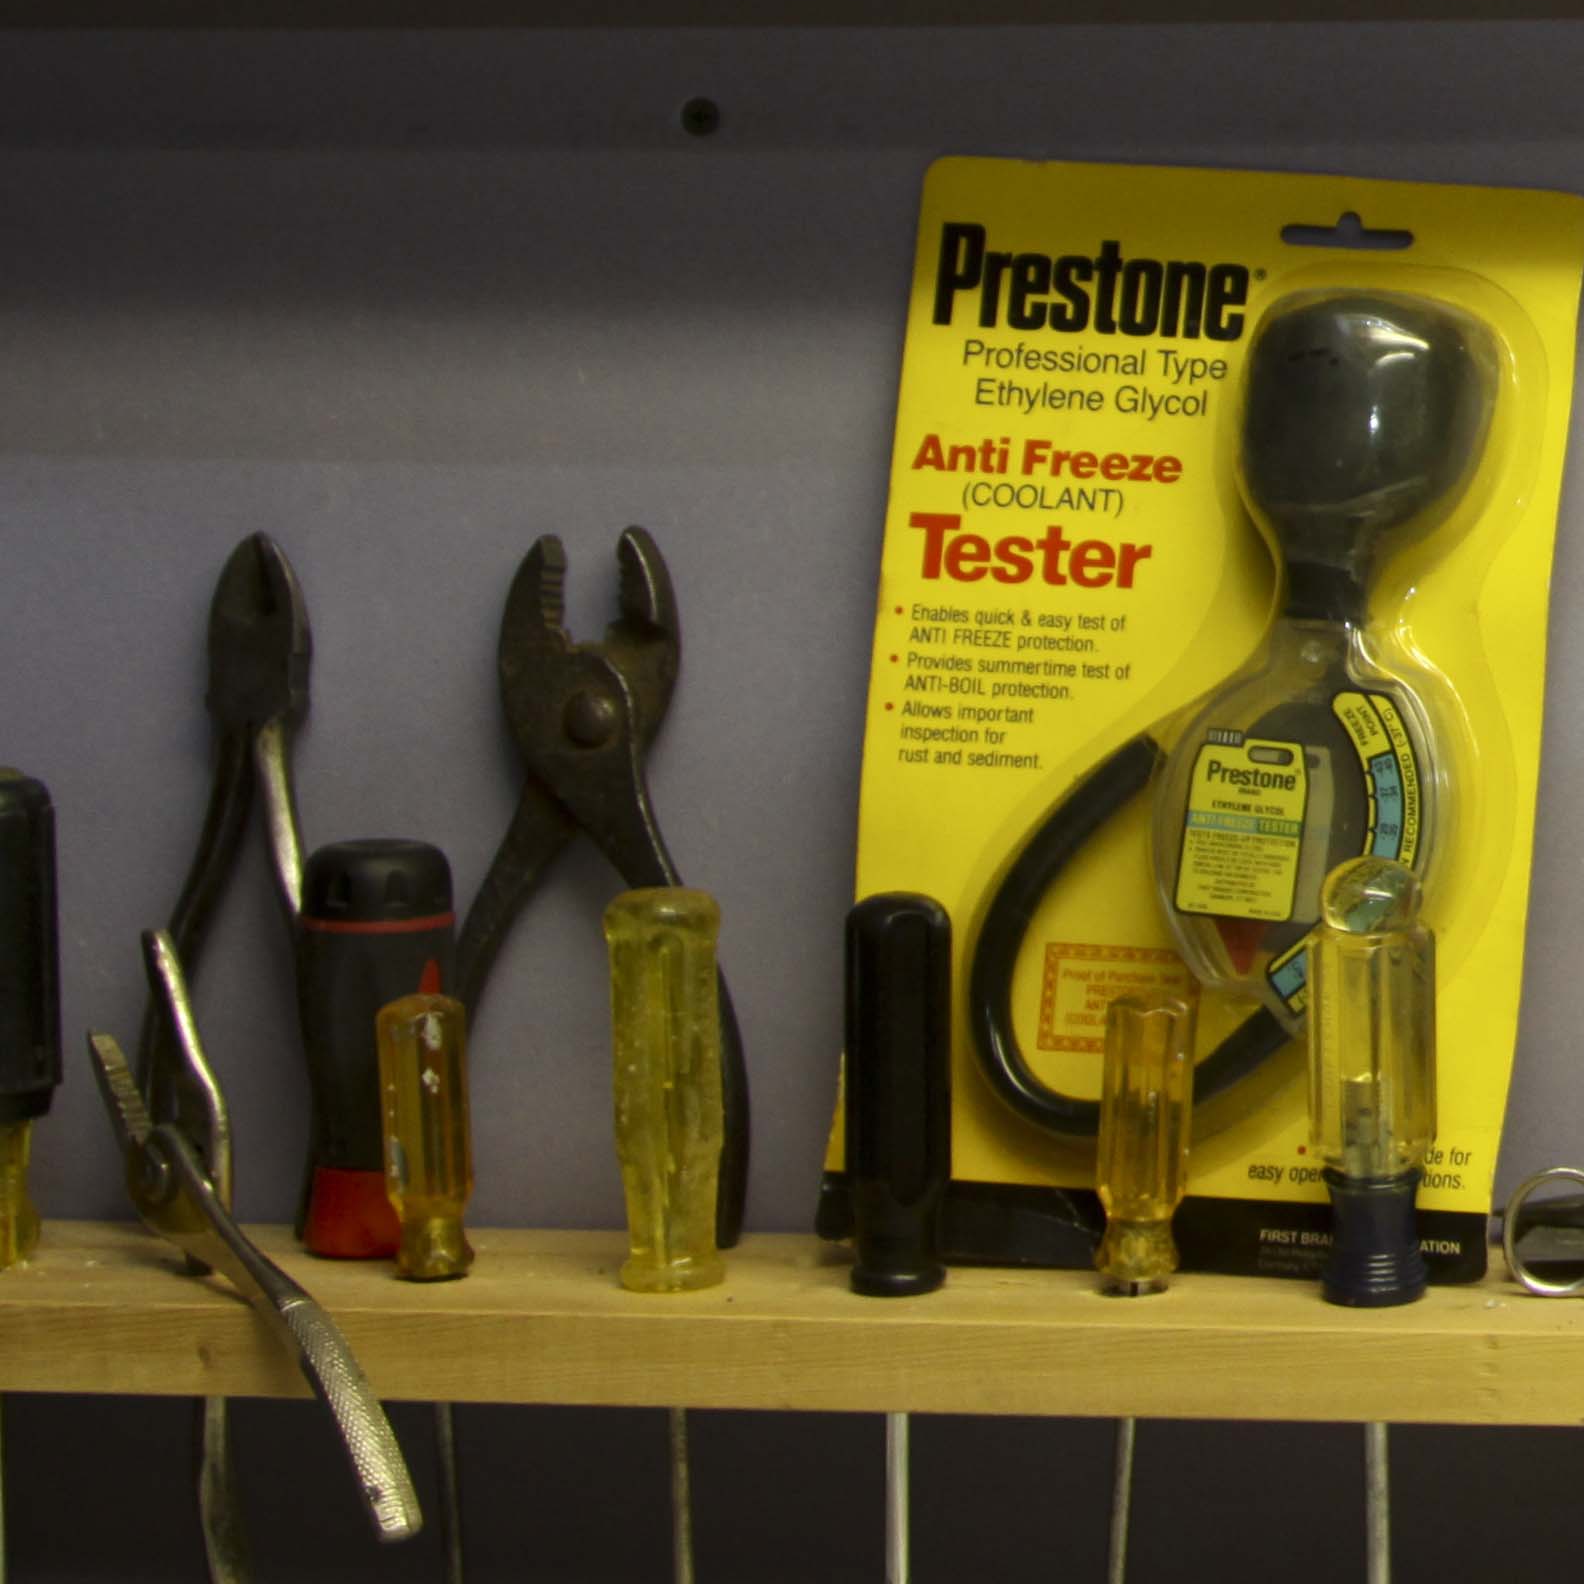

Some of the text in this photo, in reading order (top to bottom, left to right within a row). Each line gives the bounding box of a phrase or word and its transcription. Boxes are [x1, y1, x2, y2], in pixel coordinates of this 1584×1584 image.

[932, 221, 1250, 342] Prestone
[963, 339, 1229, 385] Professional Type
[975, 377, 1208, 421] Ethylene Glycol
[911, 433, 1183, 483] Anti Freeze
[962, 481, 1124, 518] (COOLANT)
[909, 512, 1152, 590] Tester
[911, 603, 1126, 632] Enables quick & easy test of
[909, 627, 1100, 654] ANTI FREEZE protection.
[906, 652, 972, 672] Provides
[1082, 662, 1110, 680] test
[1115, 663, 1131, 680] of
[904, 676, 986, 696] ANTI-BOIL
[901, 700, 1034, 724] Allows important
[900, 724, 1006, 744] inspection for
[899, 746, 1044, 770] rust and sediment.
[1206, 759, 1296, 792] Prestone
[1259, 1228, 1298, 1245] FIRST
